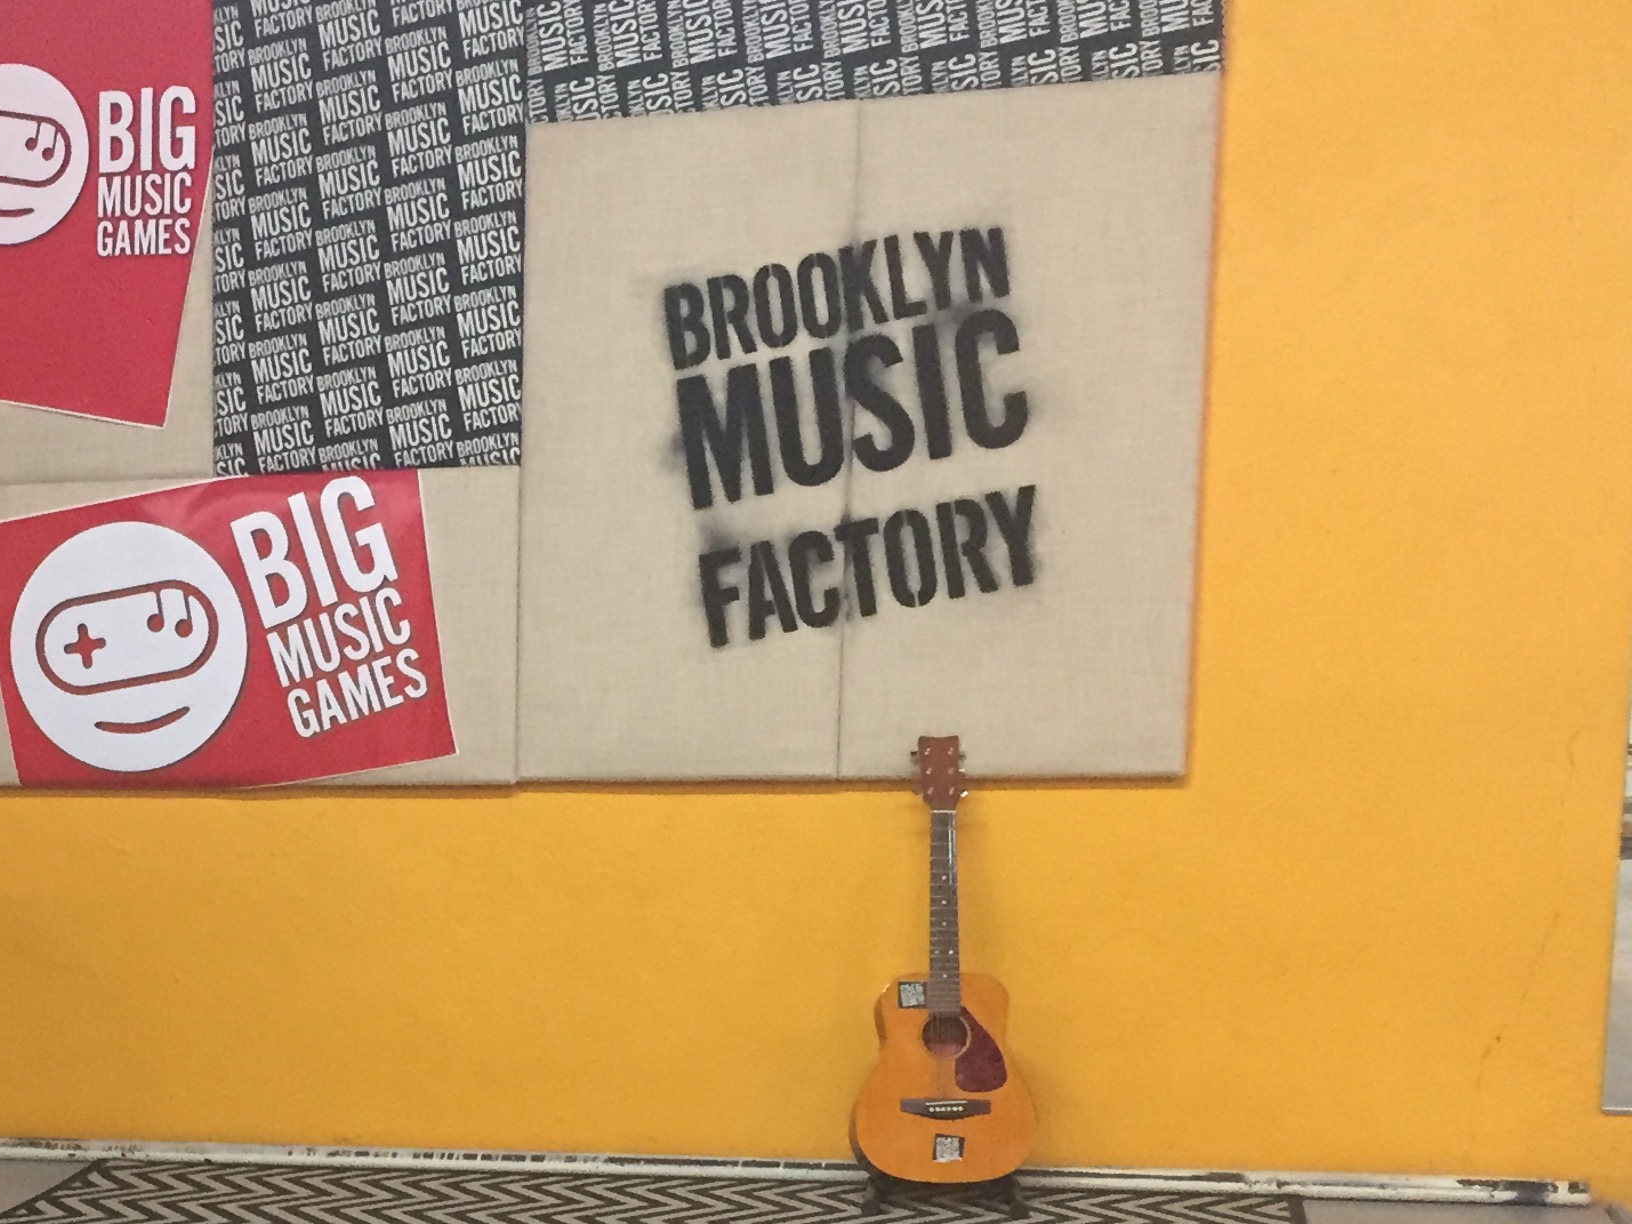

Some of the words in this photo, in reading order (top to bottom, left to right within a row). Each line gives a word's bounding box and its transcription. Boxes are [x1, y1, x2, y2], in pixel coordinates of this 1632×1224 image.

[254, 5, 313, 39] FACTORY
[318, 9, 381, 50] MUSIC
[458, 0, 524, 39] MUSIC
[608, 0, 643, 68] MUSIC
[214, 20, 244, 53] SIC
[248, 38, 307, 66] BROOKLYN
[322, 35, 383, 71] FACTORY
[384, 26, 447, 55] BROOKLYN
[462, 26, 525, 60] FACTORY
[536, 1, 569, 72] MUSIC
[593, 3, 615, 72] BROOKLYN
[214, 47, 245, 73] TORY
[251, 52, 312, 92] MUSIC
[387, 41, 451, 82] MUSIC
[455, 58, 519, 88] BROOKLYN
[948, 53, 979, 90] SIC
[316, 69, 377, 99] BROOKLYN
[391, 68, 453, 103] FACTORY
[716, 69, 747, 106] SIC
[792, 64, 823, 101] SIC
[869, 59, 901, 96] SIC
[215, 95, 245, 127] SIC
[254, 80, 313, 113] FACTORY
[318, 84, 381, 125] MUSIC
[457, 74, 523, 115] MUSIC
[99, 85, 196, 174] BIG
[248, 113, 308, 140] BROOKLYN
[322, 111, 383, 146] FACTORY
[384, 102, 447, 131] BROOKLYN
[461, 102, 524, 137] FACTORY
[215, 121, 246, 149] TORY
[251, 127, 312, 167] MUSIC
[387, 117, 451, 157] MUSIC
[454, 135, 519, 163] BROOKLYN
[255, 154, 313, 187] FACTORY
[315, 144, 377, 173] BROOKLYN
[391, 144, 452, 178] FACTORY
[457, 150, 522, 190] MUSIC
[97, 172, 192, 218] MUSIC
[215, 169, 245, 200] SIC
[318, 160, 381, 200] MUSIC
[384, 177, 446, 205] BROOKLYN
[461, 177, 523, 211] FACTORY
[215, 196, 246, 221] TORY
[248, 187, 308, 214] BROOKLYN
[322, 186, 382, 220] FACTORY
[386, 192, 450, 232] MUSIC
[96, 217, 191, 257] GAMES
[251, 202, 312, 240] MUSIC
[315, 219, 376, 247] BROOKLYN
[390, 219, 452, 252] FACTORY
[453, 210, 518, 239] BROOKLYN
[215, 242, 244, 273] SIC
[255, 228, 313, 261] FACTORY
[317, 234, 380, 273] MUSIC
[456, 225, 521, 266] MUSIC
[215, 268, 246, 294] TORY
[248, 261, 308, 287] BROOKLYN
[322, 261, 381, 293] FACTORY
[383, 252, 446, 280] BROOKLYN
[460, 253, 522, 286] FACTORY
[251, 275, 312, 313] MUSIC
[386, 267, 449, 306] MUSIC
[453, 285, 517, 313] BROOKLYN
[664, 227, 1010, 370] BROOKLYN
[255, 302, 313, 333] FACTORY
[314, 293, 376, 320] BROOKLYN
[391, 294, 452, 327] FACTORY
[456, 300, 521, 338] MUSIC
[215, 313, 245, 345] SIC
[317, 307, 380, 345] MUSIC
[384, 326, 446, 353] BROOKLYN
[215, 341, 246, 366] TORY
[248, 333, 308, 359] BROOKLYN
[322, 334, 382, 366] FACTORY
[387, 340, 450, 379] MUSIC
[460, 327, 522, 359] FACTORY
[251, 348, 313, 385] MUSIC
[316, 366, 377, 392] BROOKLYN
[391, 367, 453, 399] FACTORY
[454, 359, 518, 385] BROOKLYN
[216, 385, 246, 416] SIC
[256, 373, 314, 405] FACTORY
[319, 381, 382, 418] MUSIC
[457, 374, 522, 412] MUSIC
[215, 412, 248, 438] TORY
[250, 405, 309, 431] BROOKLYN
[324, 406, 384, 438] FACTORY
[385, 399, 448, 425] BROOKLYN
[676, 308, 1029, 510] MUSIC
[253, 420, 315, 457] MUSIC
[388, 413, 452, 451] MUSIC
[456, 432, 519, 458] BROOKLYN
[216, 457, 246, 476] SIC
[258, 445, 316, 474] FACTORY
[317, 438, 379, 464] BROOKLYN
[393, 440, 454, 468] FACTORY
[230, 475, 399, 630] BIG
[698, 484, 1037, 648] FACTORY
[267, 586, 412, 688] MUSIC
[286, 648, 428, 739] GAMES
